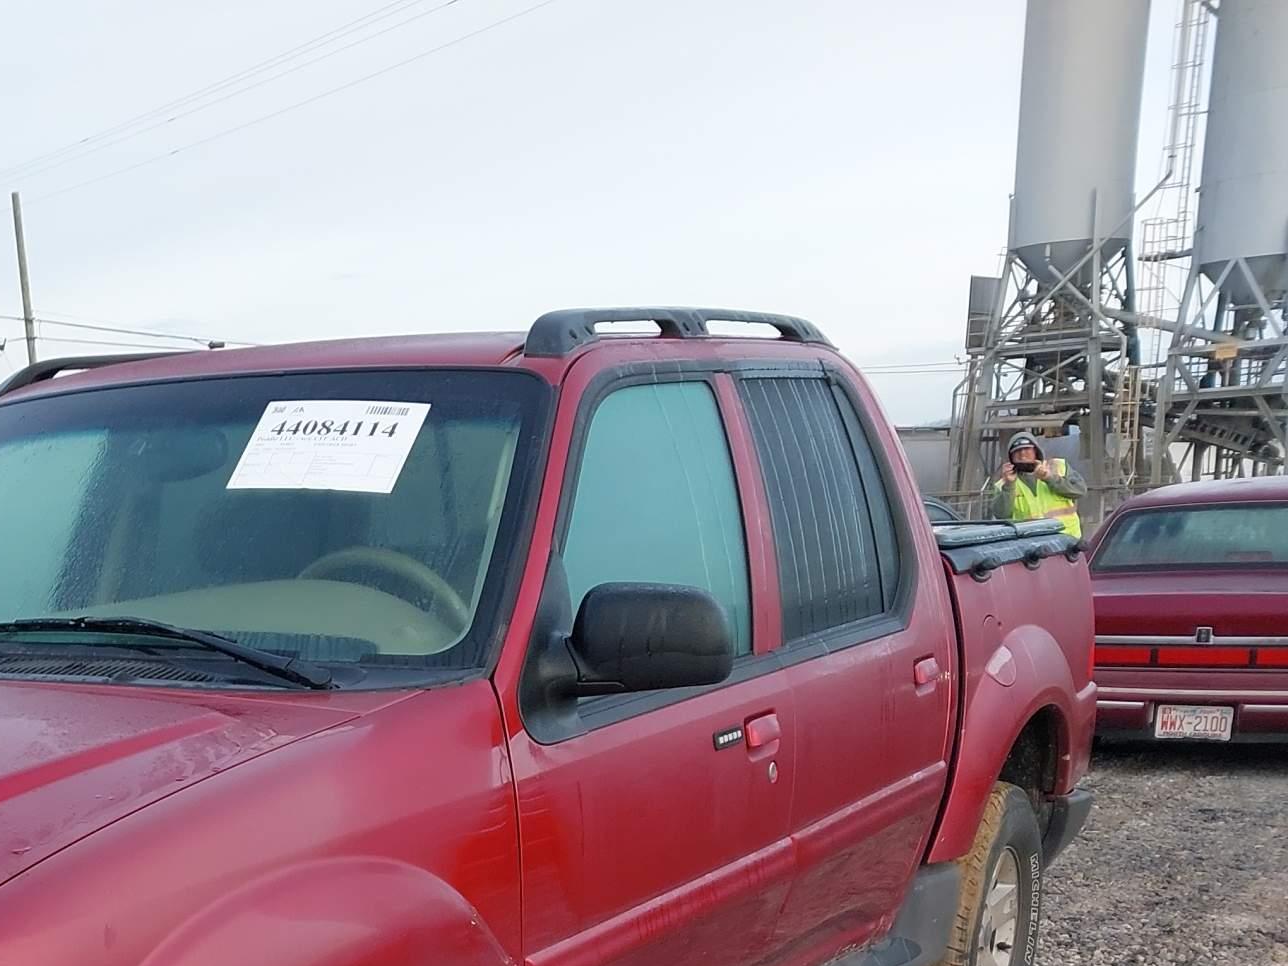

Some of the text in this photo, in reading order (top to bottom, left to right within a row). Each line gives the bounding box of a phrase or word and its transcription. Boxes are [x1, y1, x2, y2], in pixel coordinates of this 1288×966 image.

[270, 420, 399, 438] 44084114
[1160, 714, 1228, 732] WWX-2100
[1024, 852, 1040, 966] MICHELIN
